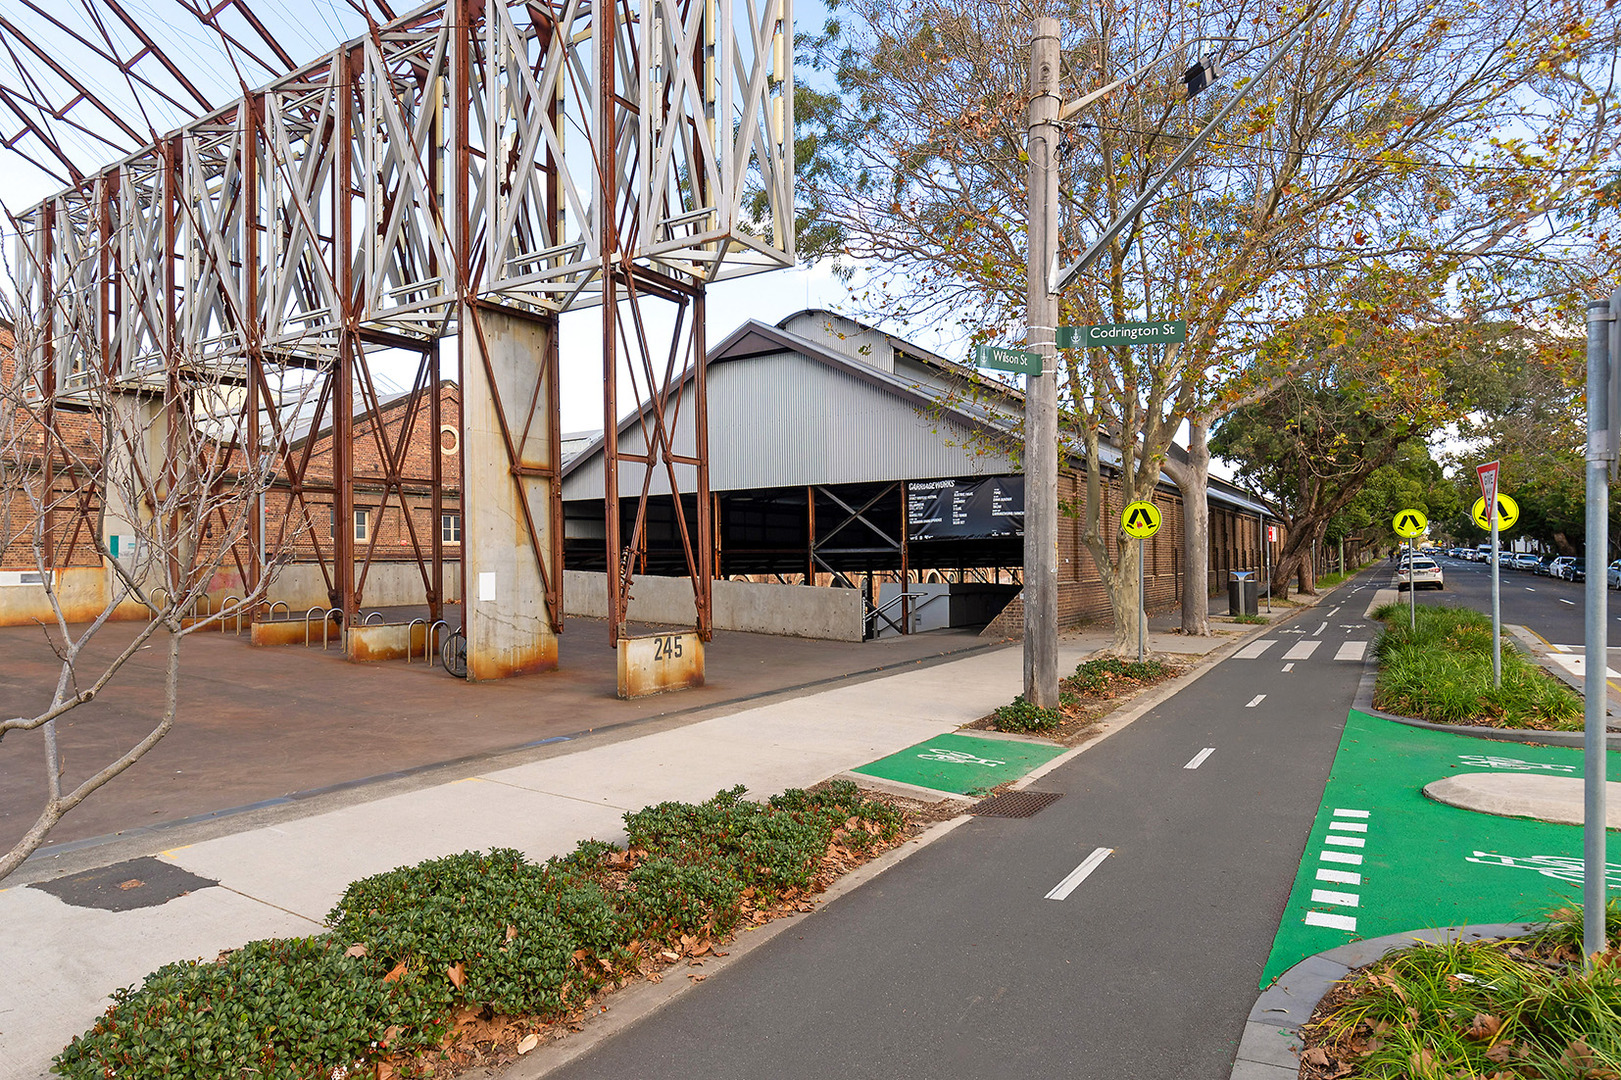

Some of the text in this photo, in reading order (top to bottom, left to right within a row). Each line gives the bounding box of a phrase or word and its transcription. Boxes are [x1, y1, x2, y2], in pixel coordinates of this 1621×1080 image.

[1090, 324, 1176, 340] Codrington St
[993, 350, 1028, 366] Wilson St
[908, 480, 955, 490] CARRIAGEWORKS
[655, 635, 682, 660] 245
